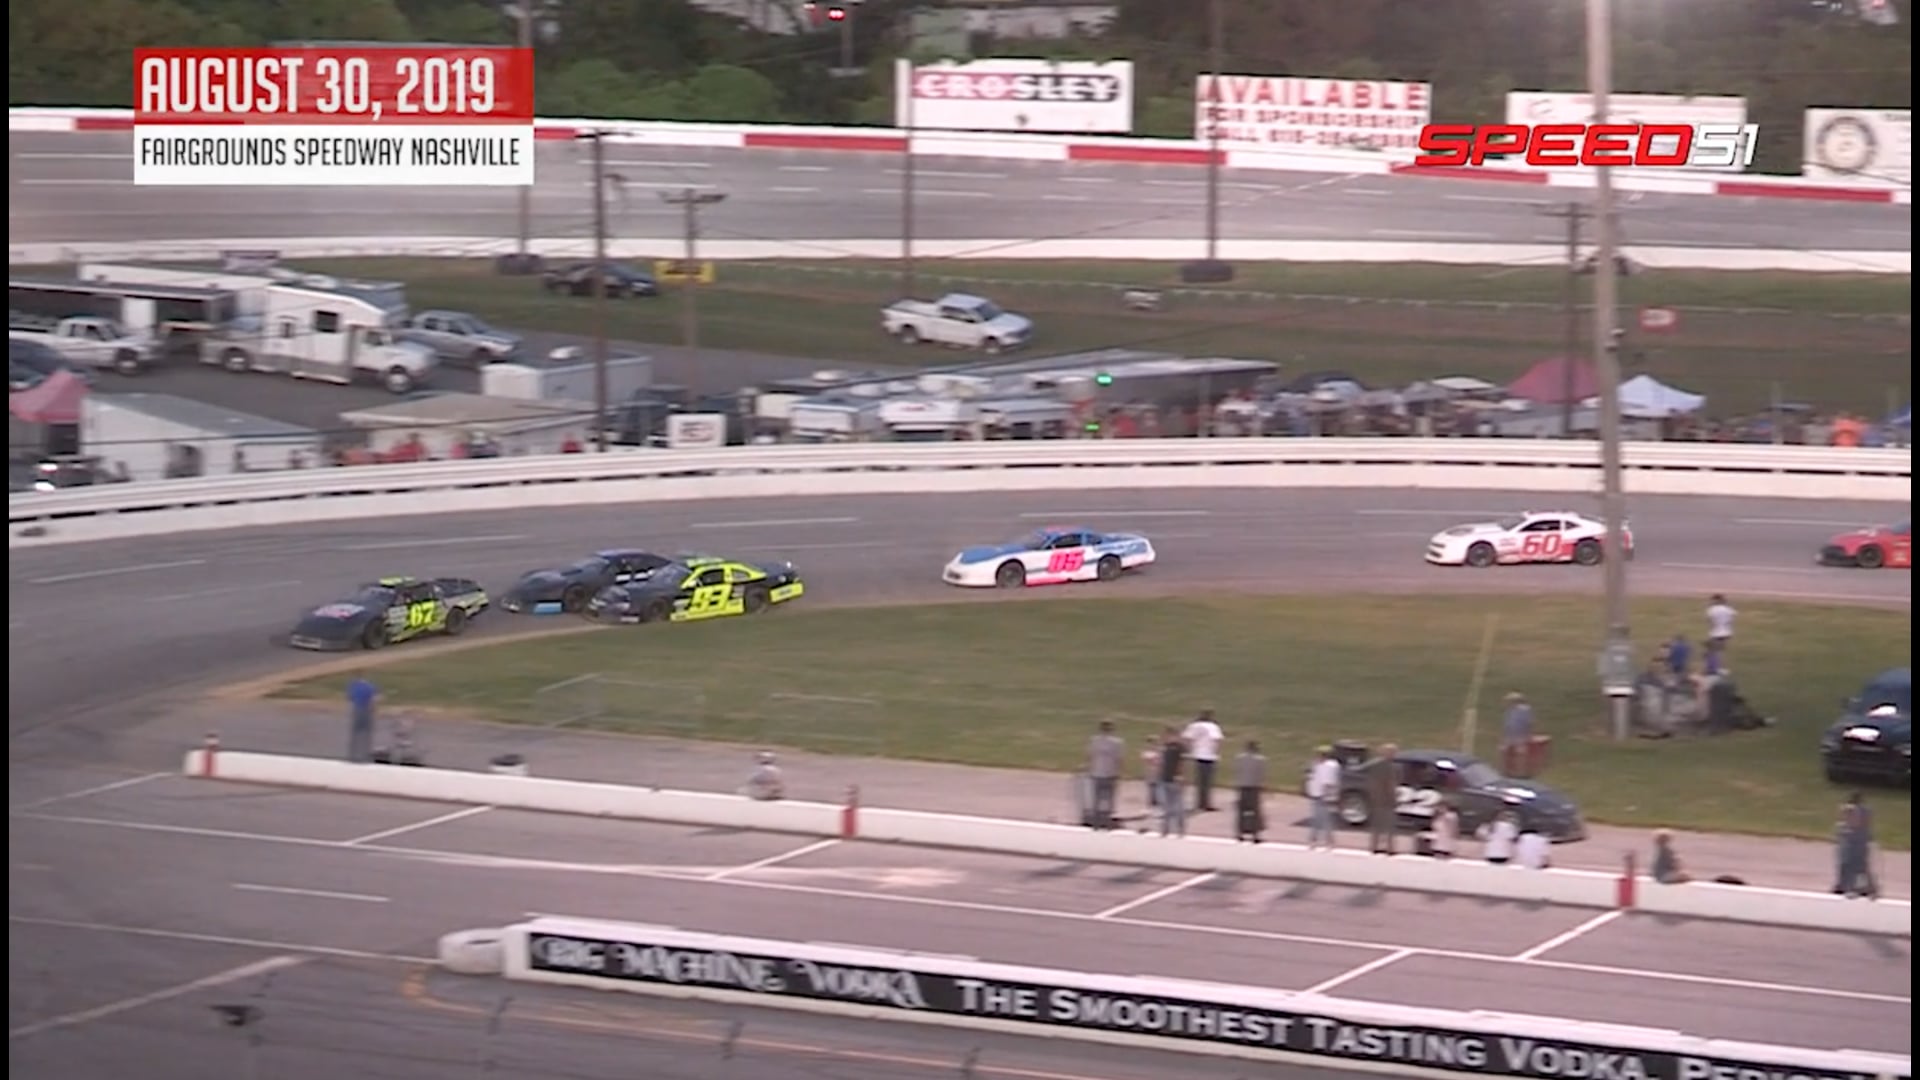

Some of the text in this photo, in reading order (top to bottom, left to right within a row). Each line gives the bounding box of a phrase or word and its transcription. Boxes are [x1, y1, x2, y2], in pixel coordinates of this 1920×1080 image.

[915, 72, 1119, 101] CROSLEY
[1202, 79, 1425, 110] AVAILABLE
[1206, 107, 1246, 122] FOR
[1521, 533, 1562, 557] 60
[689, 584, 733, 612] 93
[409, 601, 435, 626] 67
[1395, 786, 1444, 818] 22
[955, 979, 1039, 1017] THE
[1049, 988, 1297, 1045] SMOOTHEST
[1302, 1018, 1488, 1067] TASTING
